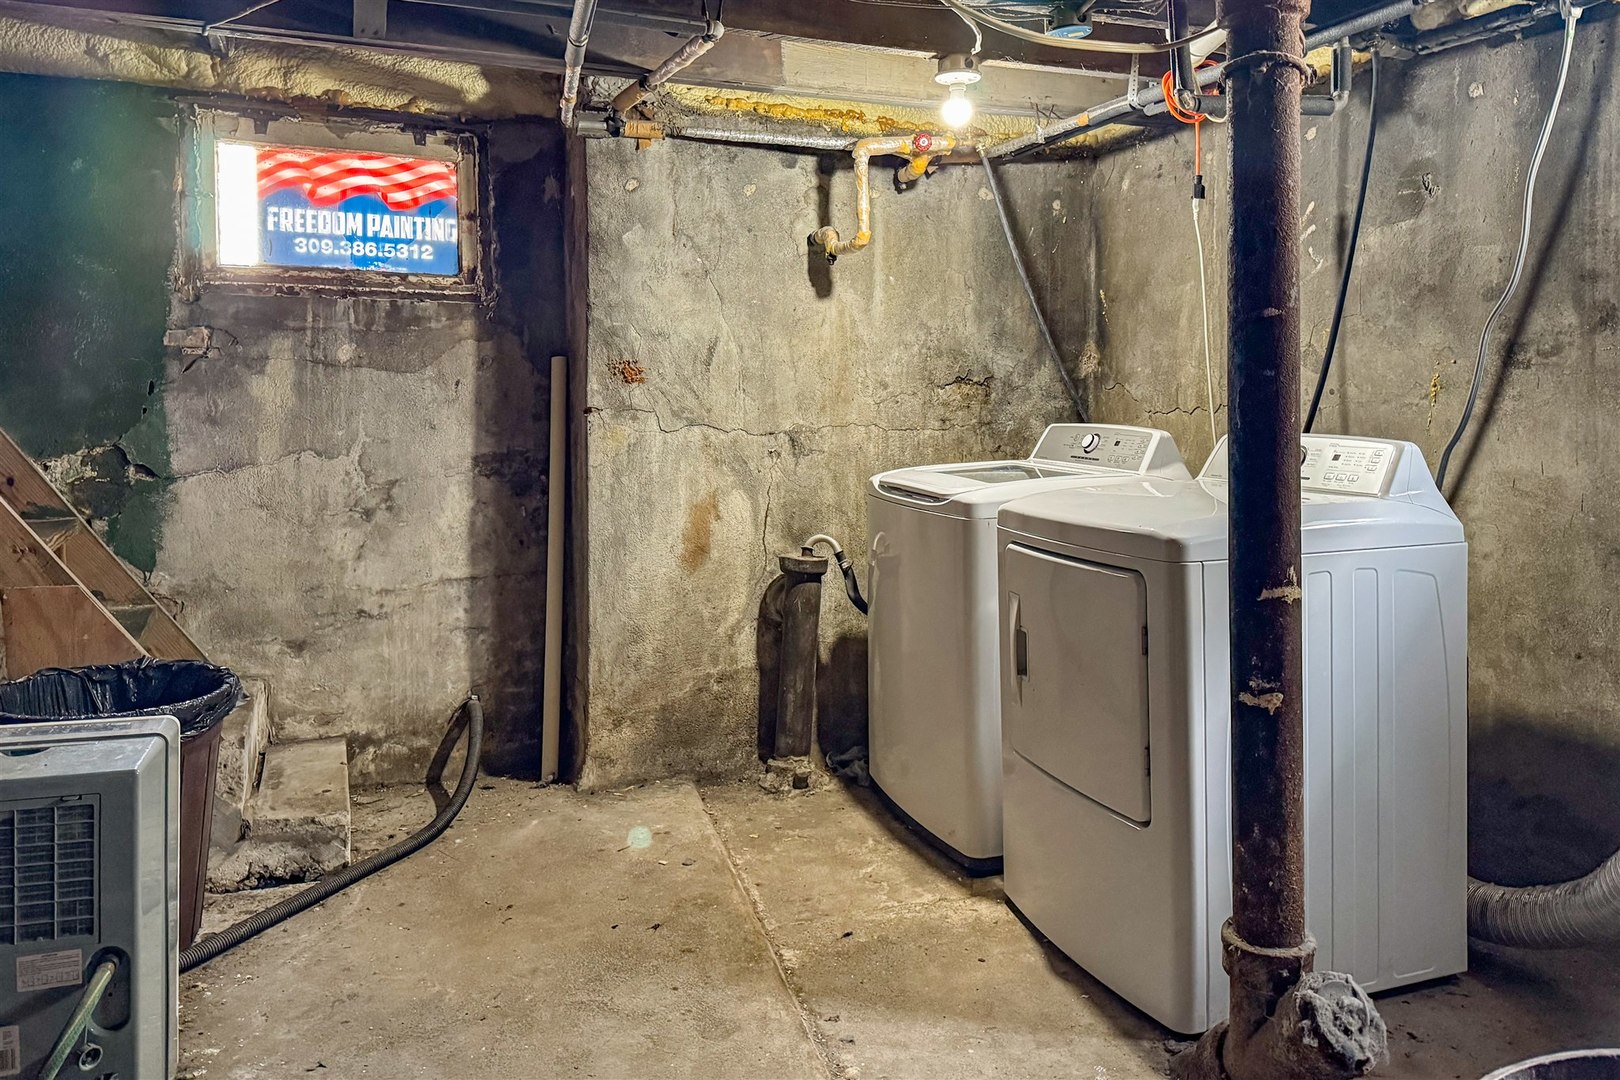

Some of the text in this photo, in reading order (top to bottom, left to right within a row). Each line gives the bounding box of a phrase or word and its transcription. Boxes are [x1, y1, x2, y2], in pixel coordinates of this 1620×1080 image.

[267, 206, 458, 242] FREEDOM PAINTING
[293, 237, 434, 260] 309.386.5312
